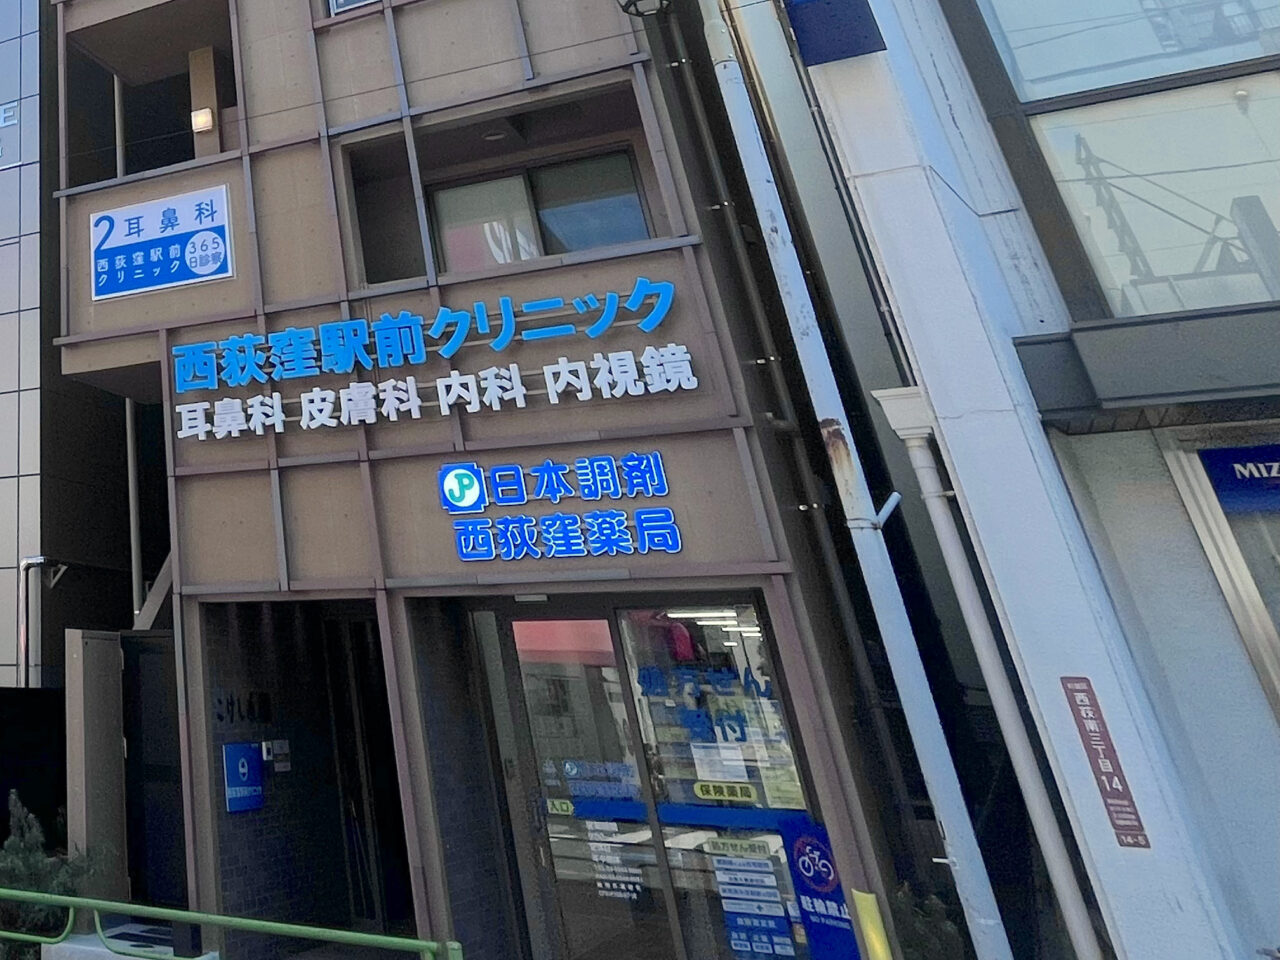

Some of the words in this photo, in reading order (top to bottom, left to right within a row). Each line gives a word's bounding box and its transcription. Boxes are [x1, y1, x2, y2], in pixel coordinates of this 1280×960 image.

[93, 215, 115, 251] 2
[124, 199, 218, 238] 耳鼻科
[189, 237, 220, 254] 365
[96, 243, 181, 273] 西荻窪駅前
[98, 260, 180, 287] クリニック
[172, 276, 676, 394] 西荻窪駅前クリニック
[175, 393, 286, 441] 耳鼻科
[299, 376, 423, 431] 皮膚科
[436, 364, 527, 416] 内科
[542, 343, 699, 404] 内視鏡
[488, 451, 670, 506] 日本調剤
[452, 506, 682, 562] 西荻窪薬局
[1073, 693, 1113, 773] 西荻南三丁目
[1101, 776, 1123, 793] 14
